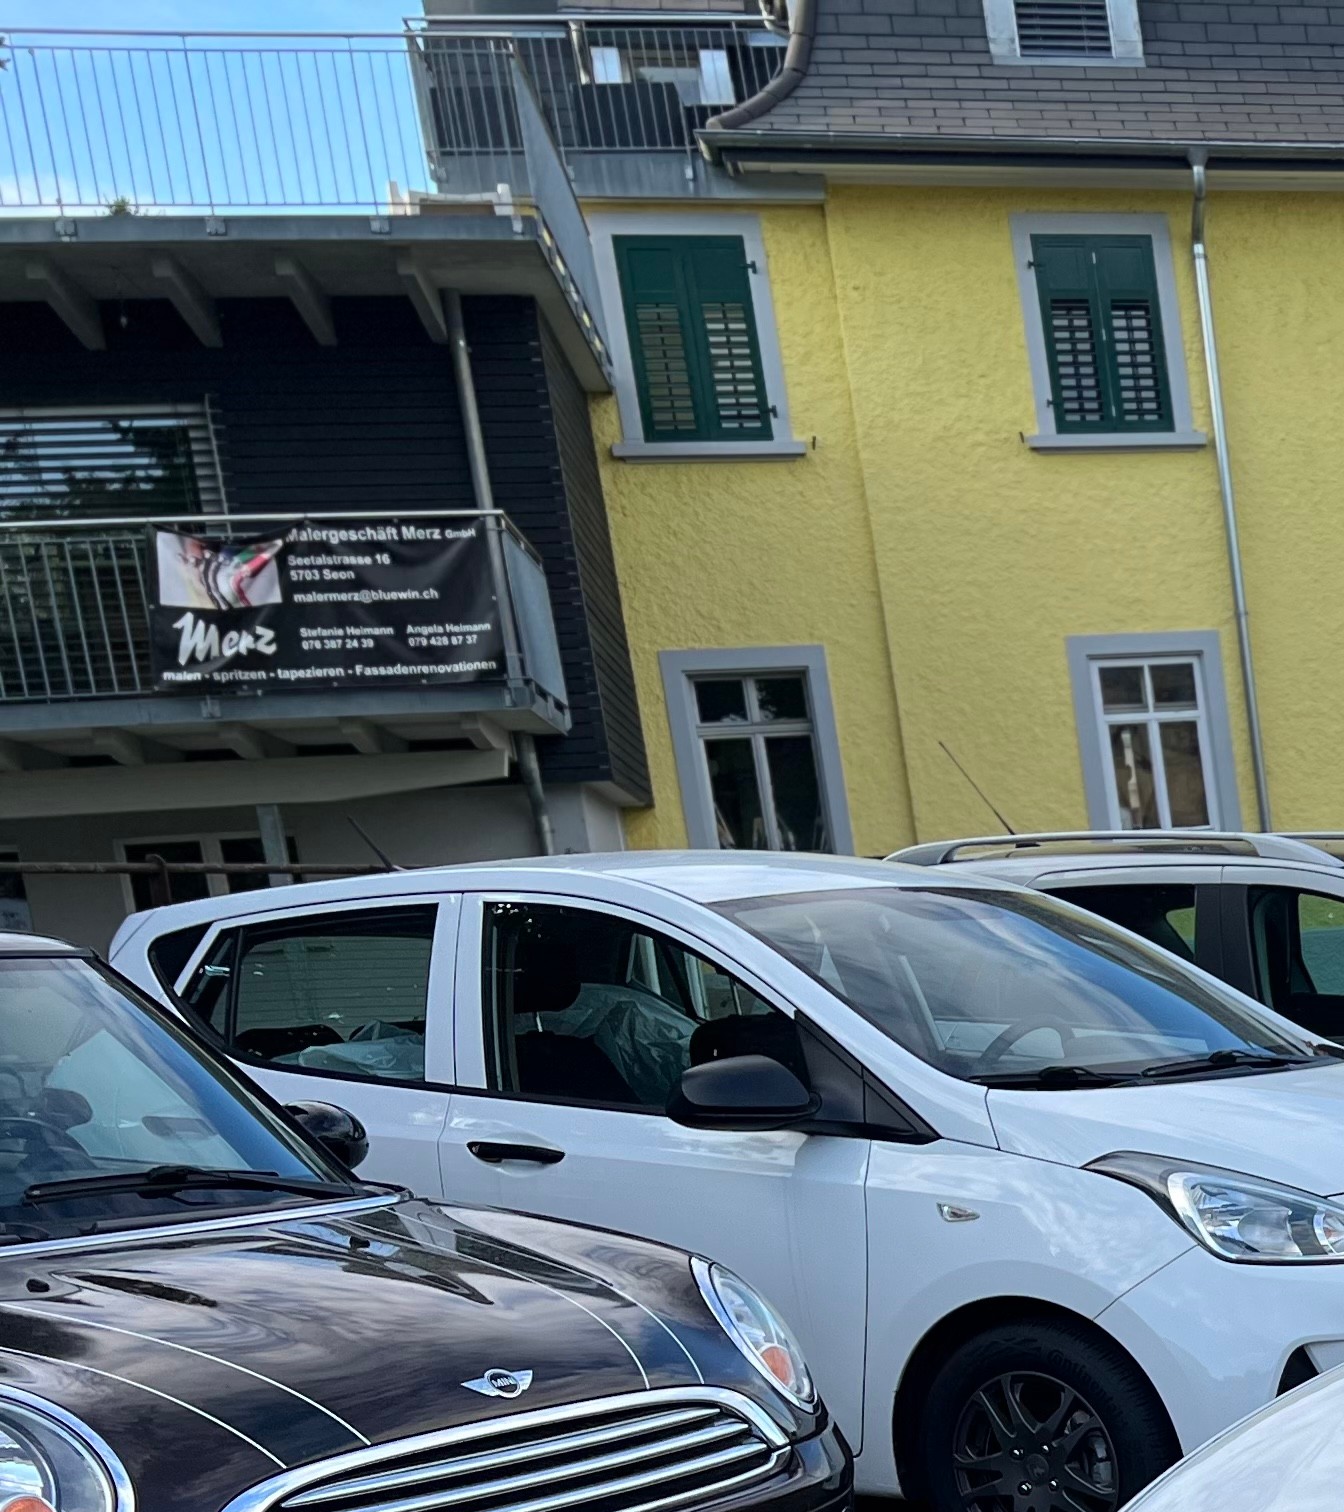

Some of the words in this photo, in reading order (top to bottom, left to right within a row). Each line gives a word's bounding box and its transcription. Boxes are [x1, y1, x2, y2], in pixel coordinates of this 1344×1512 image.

[286, 526, 399, 544] Malergeschäft
[402, 525, 442, 540] Merz
[445, 527, 476, 539] GmbH
[287, 553, 372, 566] Seetalstrasse
[375, 553, 391, 565] 16
[290, 569, 320, 581] 5703
[322, 568, 356, 580] Seon
[293, 588, 439, 603] malermerz@bluewin.ch
[300, 626, 344, 637] Stefanie
[406, 624, 444, 636] Angela
[172, 611, 277, 666] Merz
[163, 671, 202, 681] malen
[212, 669, 267, 683] spritzen
[277, 666, 345, 681] tapezieren
[355, 661, 497, 676] Fassadenrenovationen
[491, 1376, 518, 1388] MINI
